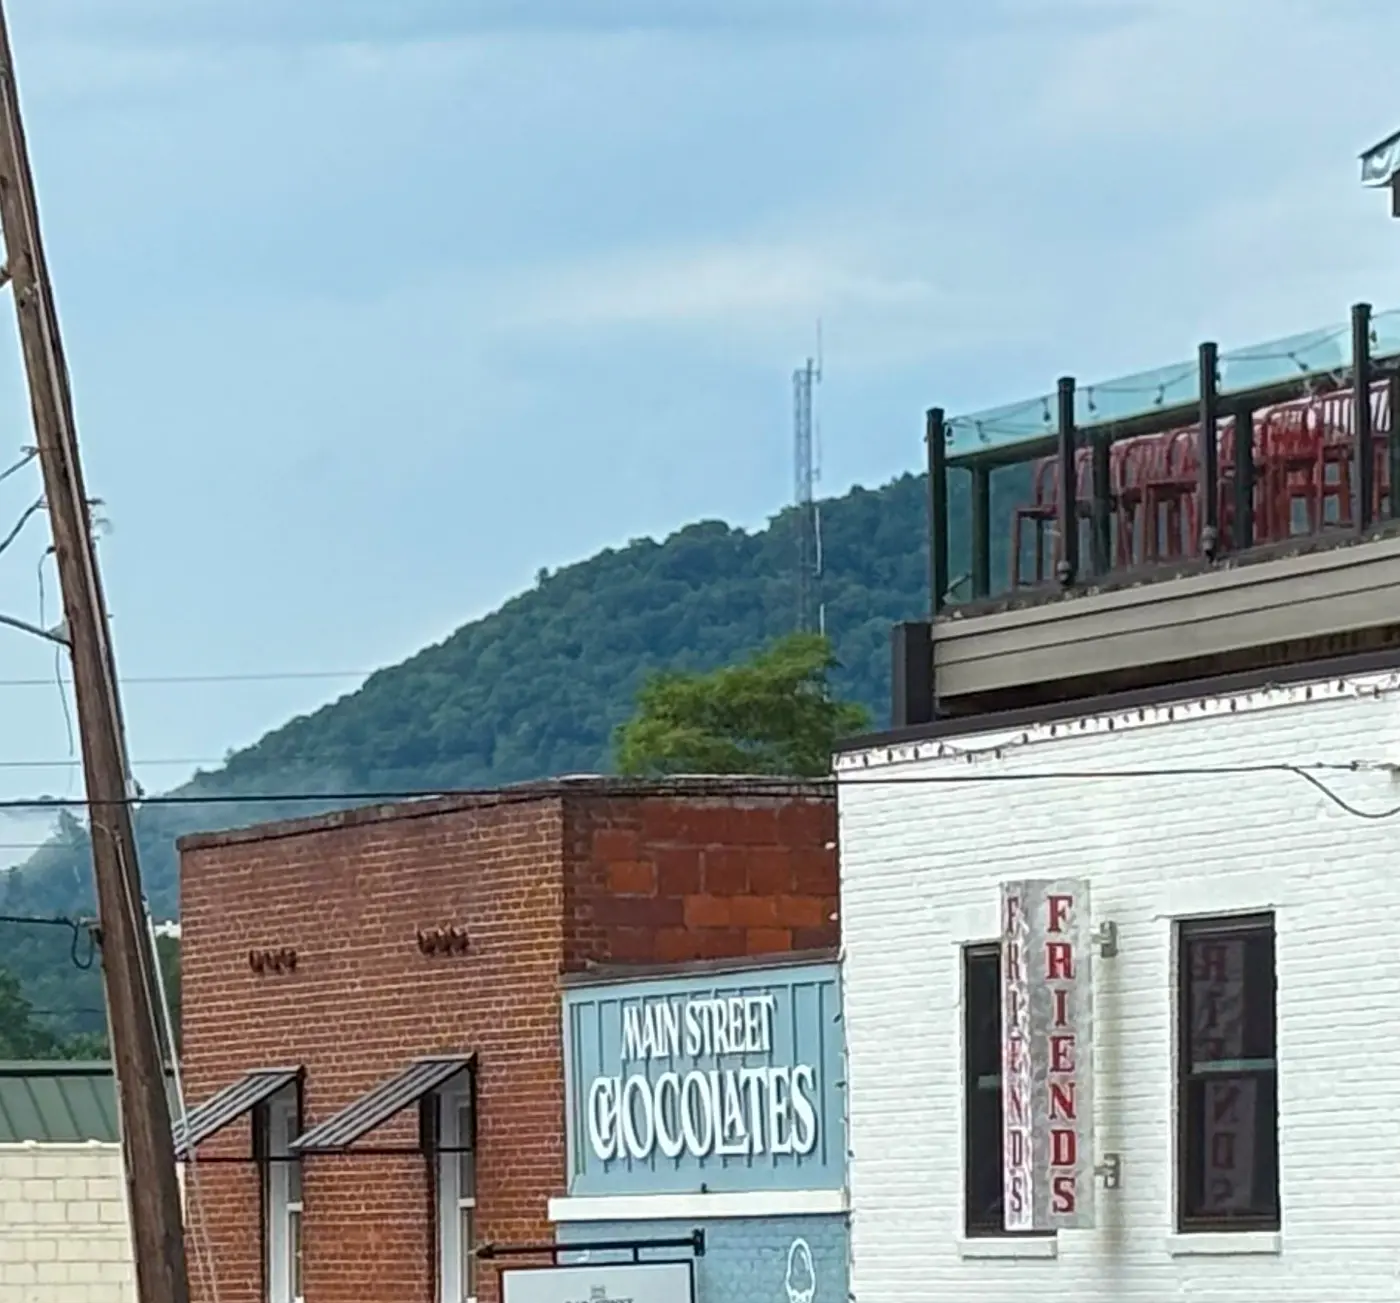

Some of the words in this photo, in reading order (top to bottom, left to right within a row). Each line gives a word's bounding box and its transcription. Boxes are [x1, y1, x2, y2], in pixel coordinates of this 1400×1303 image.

[620, 1001, 681, 1060] MAIN
[685, 995, 775, 1057] STREET
[1046, 895, 1077, 1214] FRIENDS
[588, 1064, 818, 1161] CHOCOLATES
